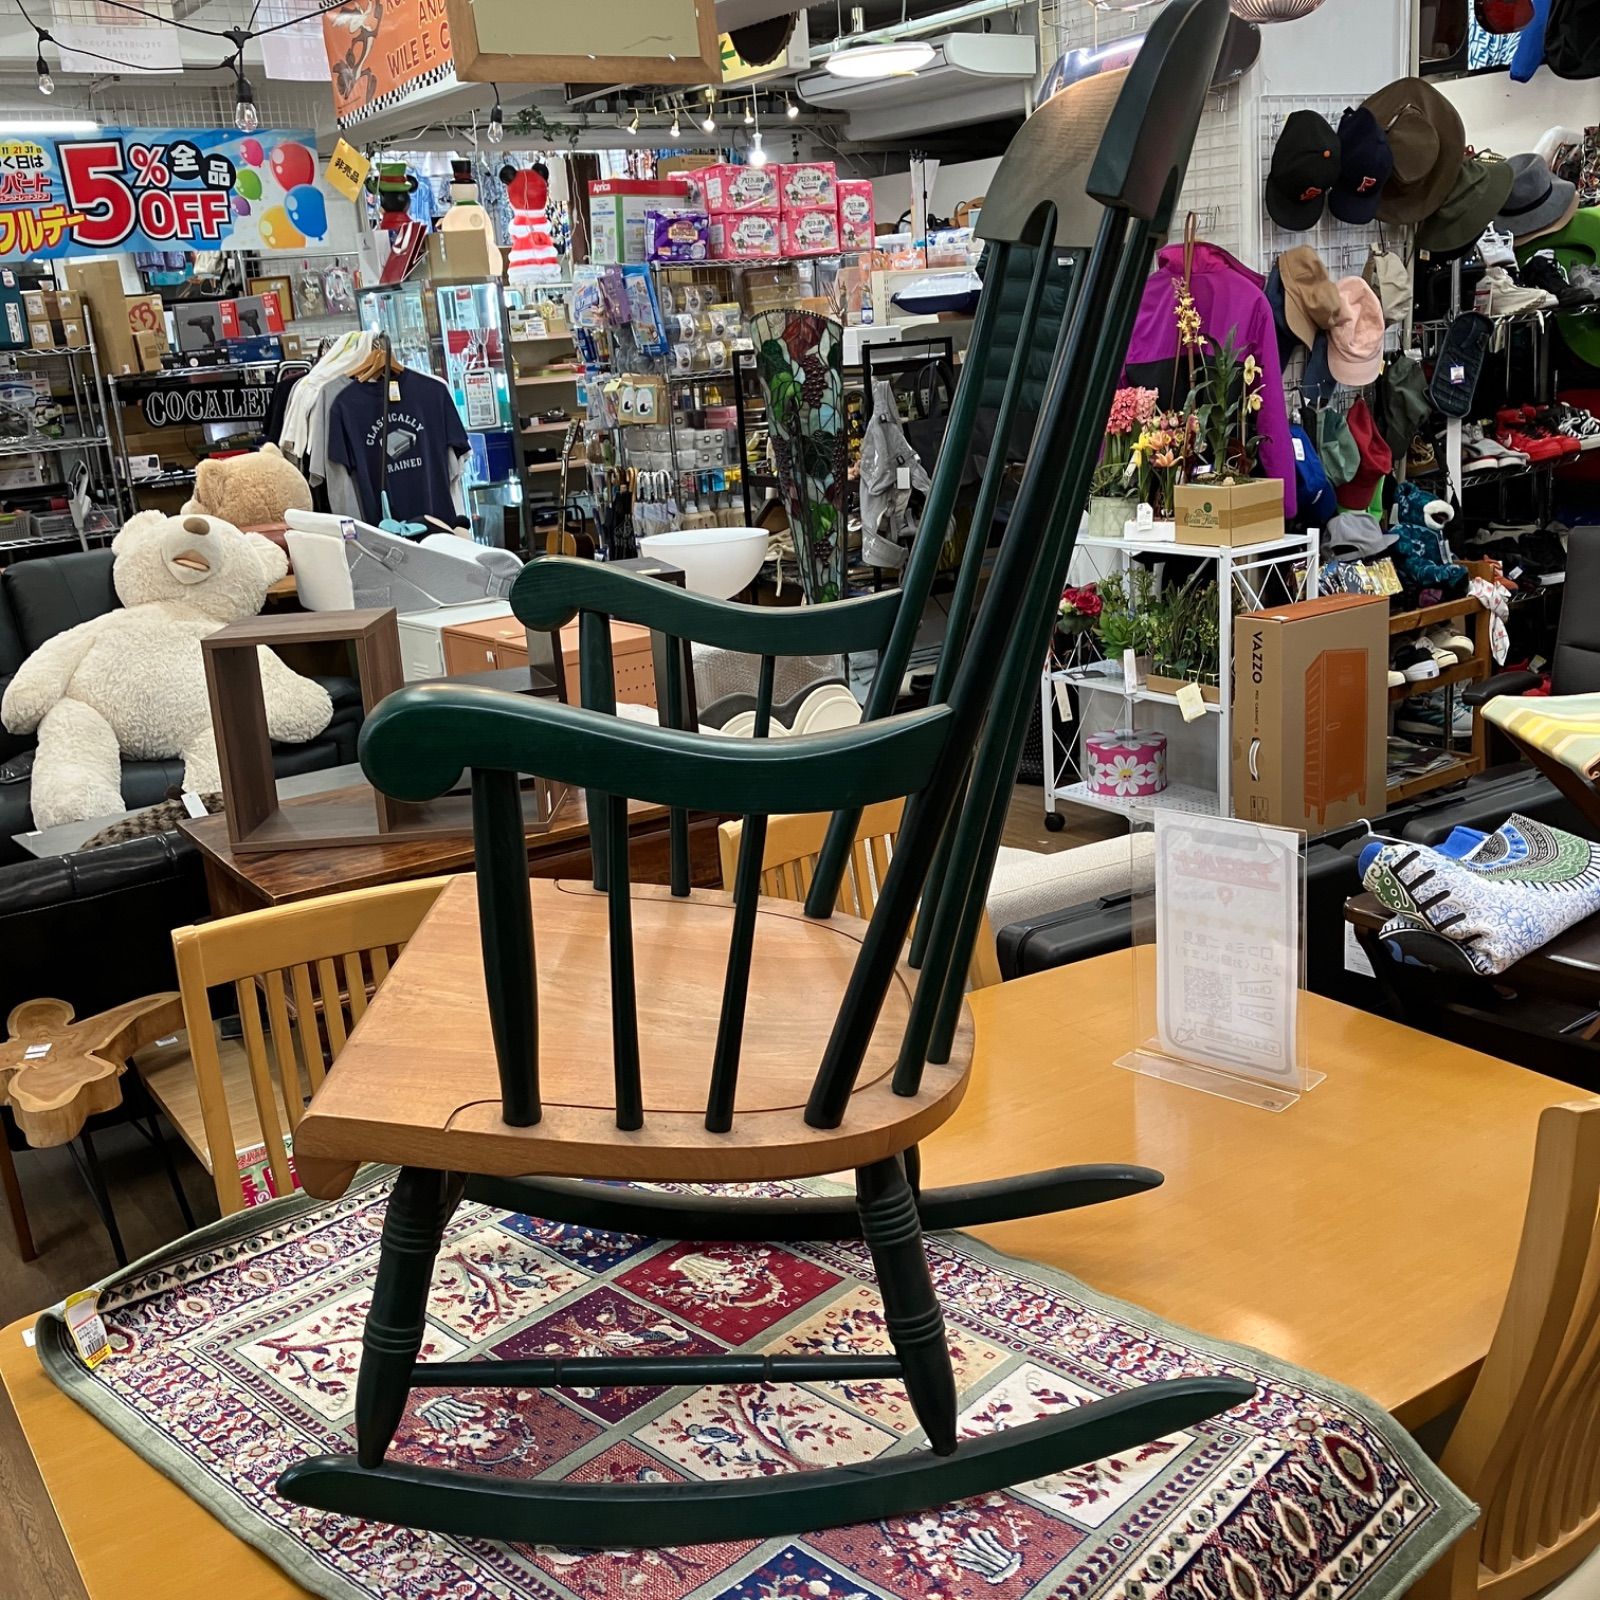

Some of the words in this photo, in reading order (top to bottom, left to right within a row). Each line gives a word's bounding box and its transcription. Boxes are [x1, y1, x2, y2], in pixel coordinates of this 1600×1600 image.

[386, 40, 420, 79] WILE
[0, 155, 44, 169] く日は
[334, 157, 360, 184] 非売品
[138, 188, 232, 242] OFF
[366, 412, 424, 446] CLASICALLY
[1252, 631, 1263, 684] VAZZO
